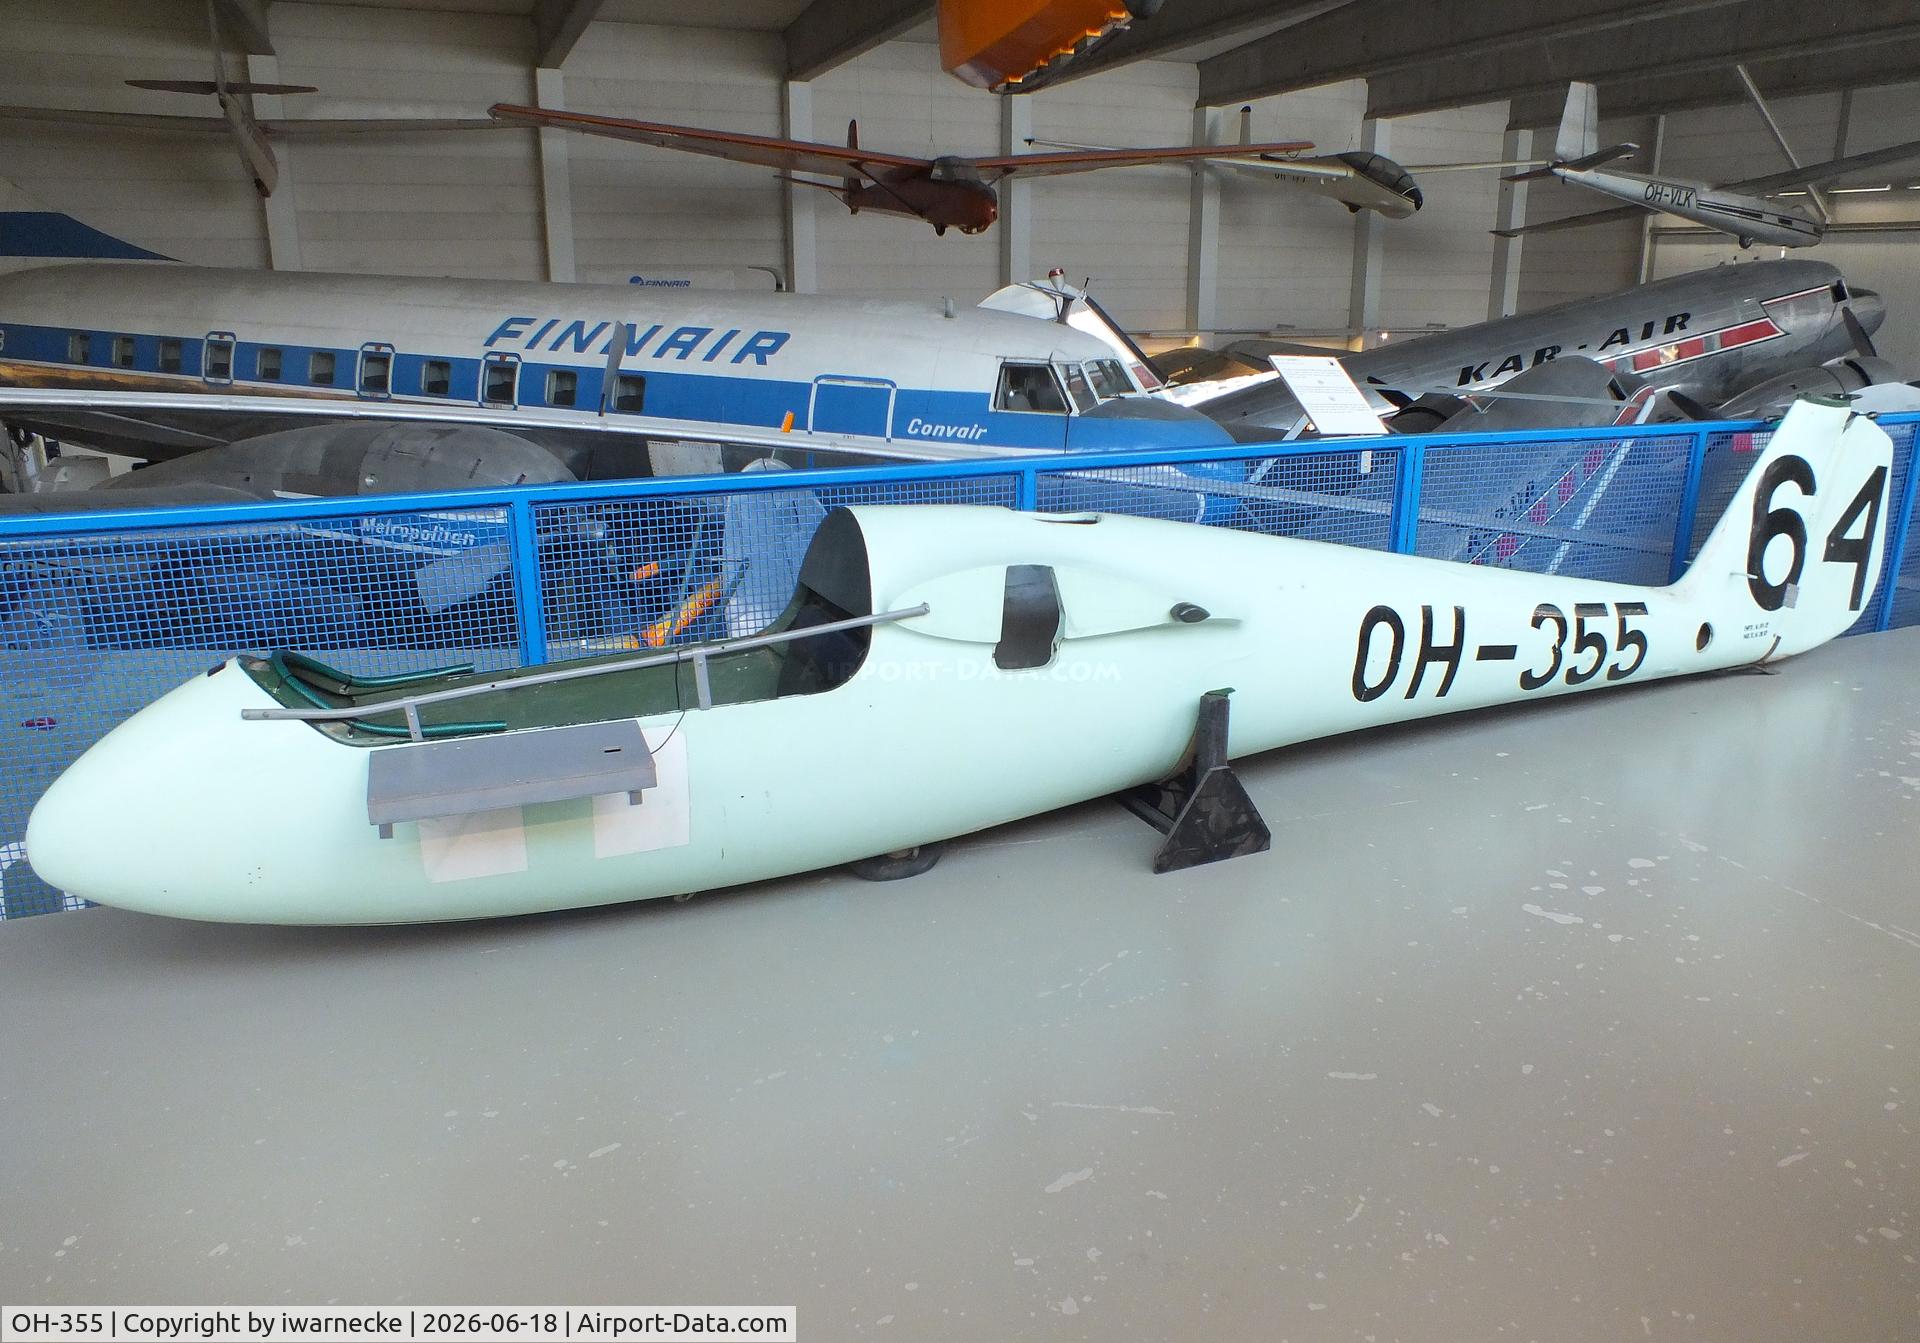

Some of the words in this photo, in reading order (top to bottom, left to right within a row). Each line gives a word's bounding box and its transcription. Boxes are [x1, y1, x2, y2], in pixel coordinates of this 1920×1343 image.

[1645, 183, 1693, 208] OH-VLK
[484, 317, 791, 365] FINNAIR
[907, 418, 988, 440] Convair
[360, 517, 476, 546] Metropolitan
[1747, 454, 1888, 612] 64
[1352, 601, 1648, 702] OH-355
